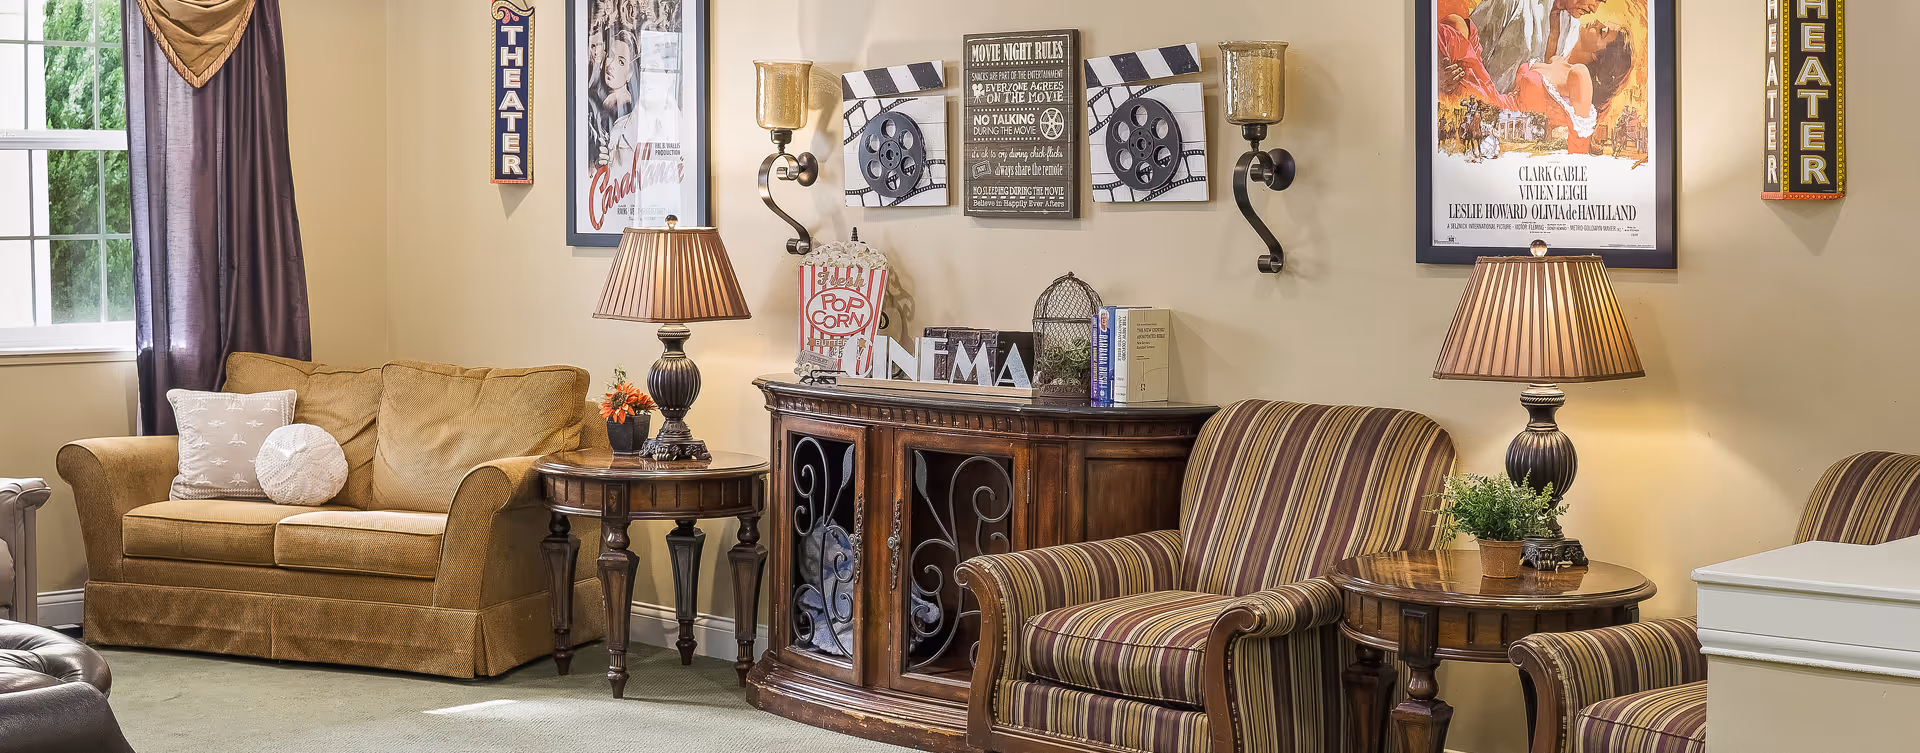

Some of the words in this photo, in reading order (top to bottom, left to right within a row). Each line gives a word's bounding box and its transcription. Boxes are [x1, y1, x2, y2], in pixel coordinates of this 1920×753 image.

[972, 44, 1000, 62] MOVIE
[1003, 42, 1032, 61] NIGHT
[1034, 40, 1063, 60] RULES
[972, 72, 989, 81] SNACKS
[990, 72, 998, 80] ARE
[999, 71, 1010, 80] PART
[1010, 70, 1016, 80] OF
[1018, 70, 1026, 79] THE
[1028, 69, 1063, 79] ENTERTAINMENT
[986, 82, 1028, 92] EVERYONE
[1030, 81, 1064, 91] AGREES
[1766, 0, 1778, 184] HEATER
[1794, 0, 1832, 184] HEATER
[498, 25, 525, 175] THEATER
[986, 92, 1000, 104] ON
[1004, 92, 1025, 103] THE
[1028, 91, 1064, 103] MOVIE
[973, 114, 990, 126] NO
[992, 113, 1036, 125] TALKING
[973, 126, 999, 135] DURING
[1000, 126, 1012, 135] THE
[1014, 126, 1036, 134] MOVIE
[998, 151, 1007, 162] cry
[1009, 148, 1029, 162] during
[995, 162, 1014, 177] always
[1015, 162, 1031, 176] share
[1032, 162, 1042, 176] the
[1042, 163, 1063, 176] remote
[1518, 166, 1552, 182] CLARK
[1554, 166, 1588, 182] GABLE
[973, 187, 982, 195] NO
[983, 187, 1008, 195] SLEEPING
[1010, 187, 1032, 195] DURING
[1033, 187, 1043, 195] THE
[1044, 187, 1064, 195] MOVIE
[1519, 185, 1554, 200] VIVIEN
[1556, 185, 1588, 200] LEIGH
[1004, 200, 1027, 208] Happily
[1449, 204, 1483, 219] LESLIE
[1485, 204, 1528, 220] HOWARD
[1531, 204, 1565, 220] OLIVIA
[817, 271, 866, 288] Fresh
[821, 293, 864, 314] POP
[812, 310, 864, 329] CORN
[1099, 335, 1108, 364] BARBARA
[842, 335, 1032, 389] CINEMA
[1099, 367, 1108, 388] BUSH
